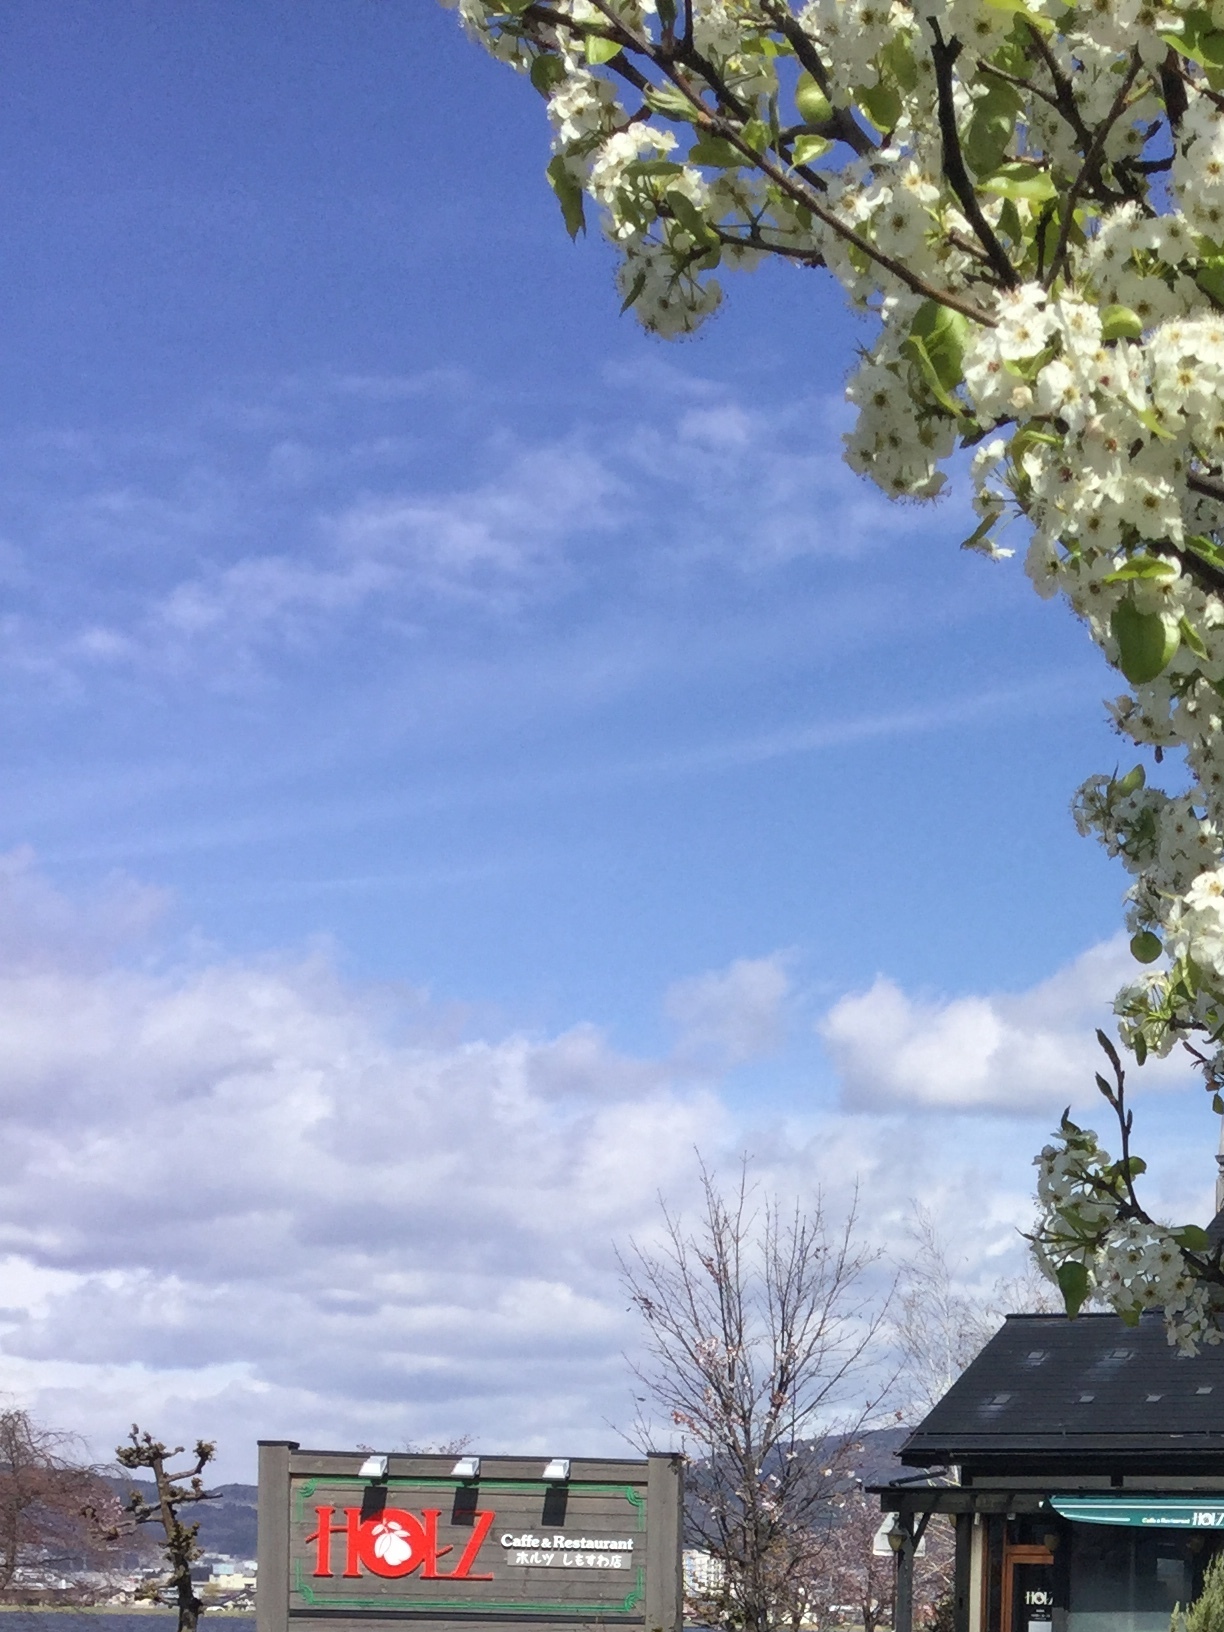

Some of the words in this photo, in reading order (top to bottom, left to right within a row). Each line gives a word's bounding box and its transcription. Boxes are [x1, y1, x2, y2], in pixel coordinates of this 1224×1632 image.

[306, 1506, 496, 1581] HOLZ
[500, 1534, 540, 1548] Caffe
[541, 1537, 552, 1549] &
[553, 1535, 634, 1550] Restaurant
[516, 1551, 554, 1566] ホルツ
[562, 1553, 622, 1569] しもすわ店
